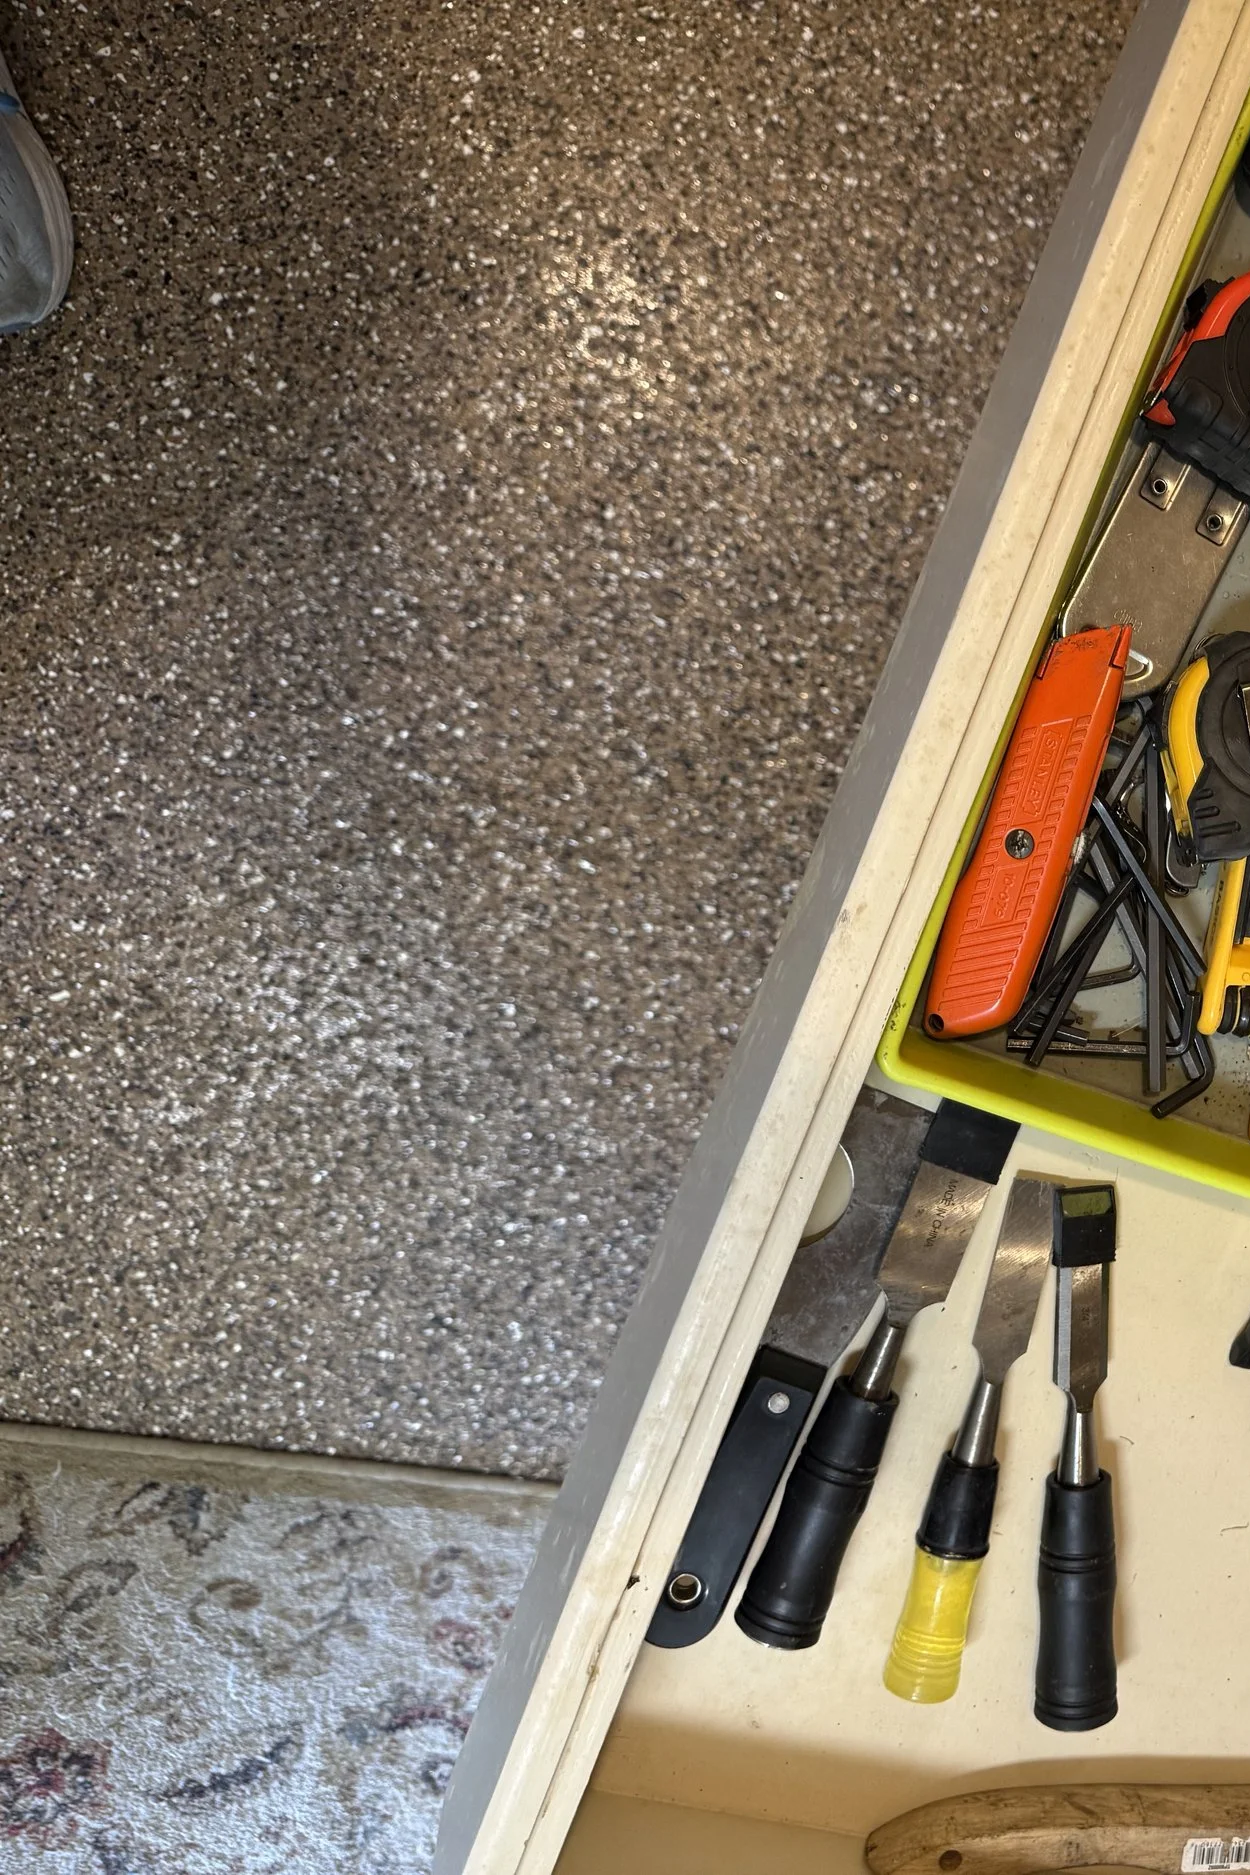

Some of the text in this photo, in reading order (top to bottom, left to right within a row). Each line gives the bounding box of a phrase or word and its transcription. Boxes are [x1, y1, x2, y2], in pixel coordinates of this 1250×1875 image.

[1028, 736, 1058, 812] STANLEY
[924, 1179, 958, 1247] MADE IN CHINA
